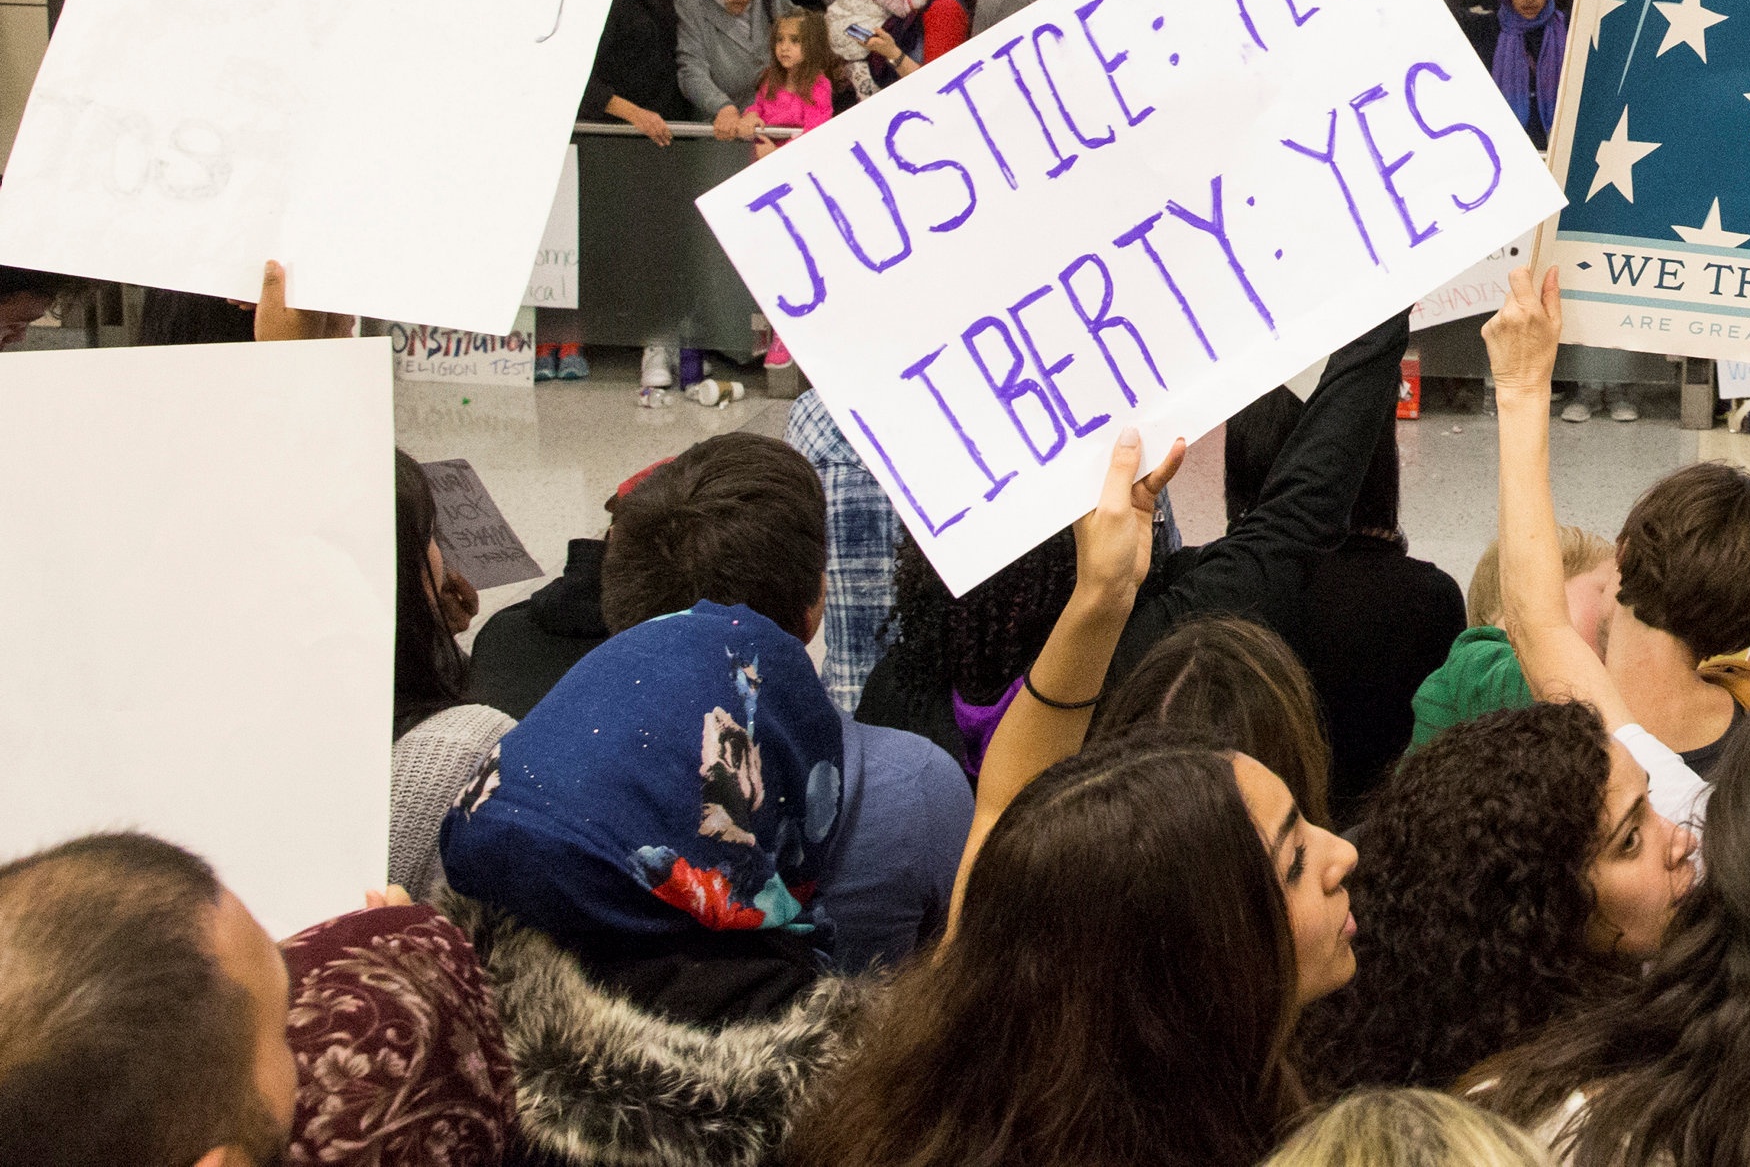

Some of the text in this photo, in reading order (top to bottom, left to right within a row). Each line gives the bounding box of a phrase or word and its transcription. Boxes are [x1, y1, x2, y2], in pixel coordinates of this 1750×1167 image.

[1602, 252, 1685, 291] WE
[849, 60, 1502, 537] LIBERTY: YES
[392, 322, 533, 360] ONSTITUTION
[1620, 315, 1672, 333] ARE
[402, 359, 478, 377] ELIGION
